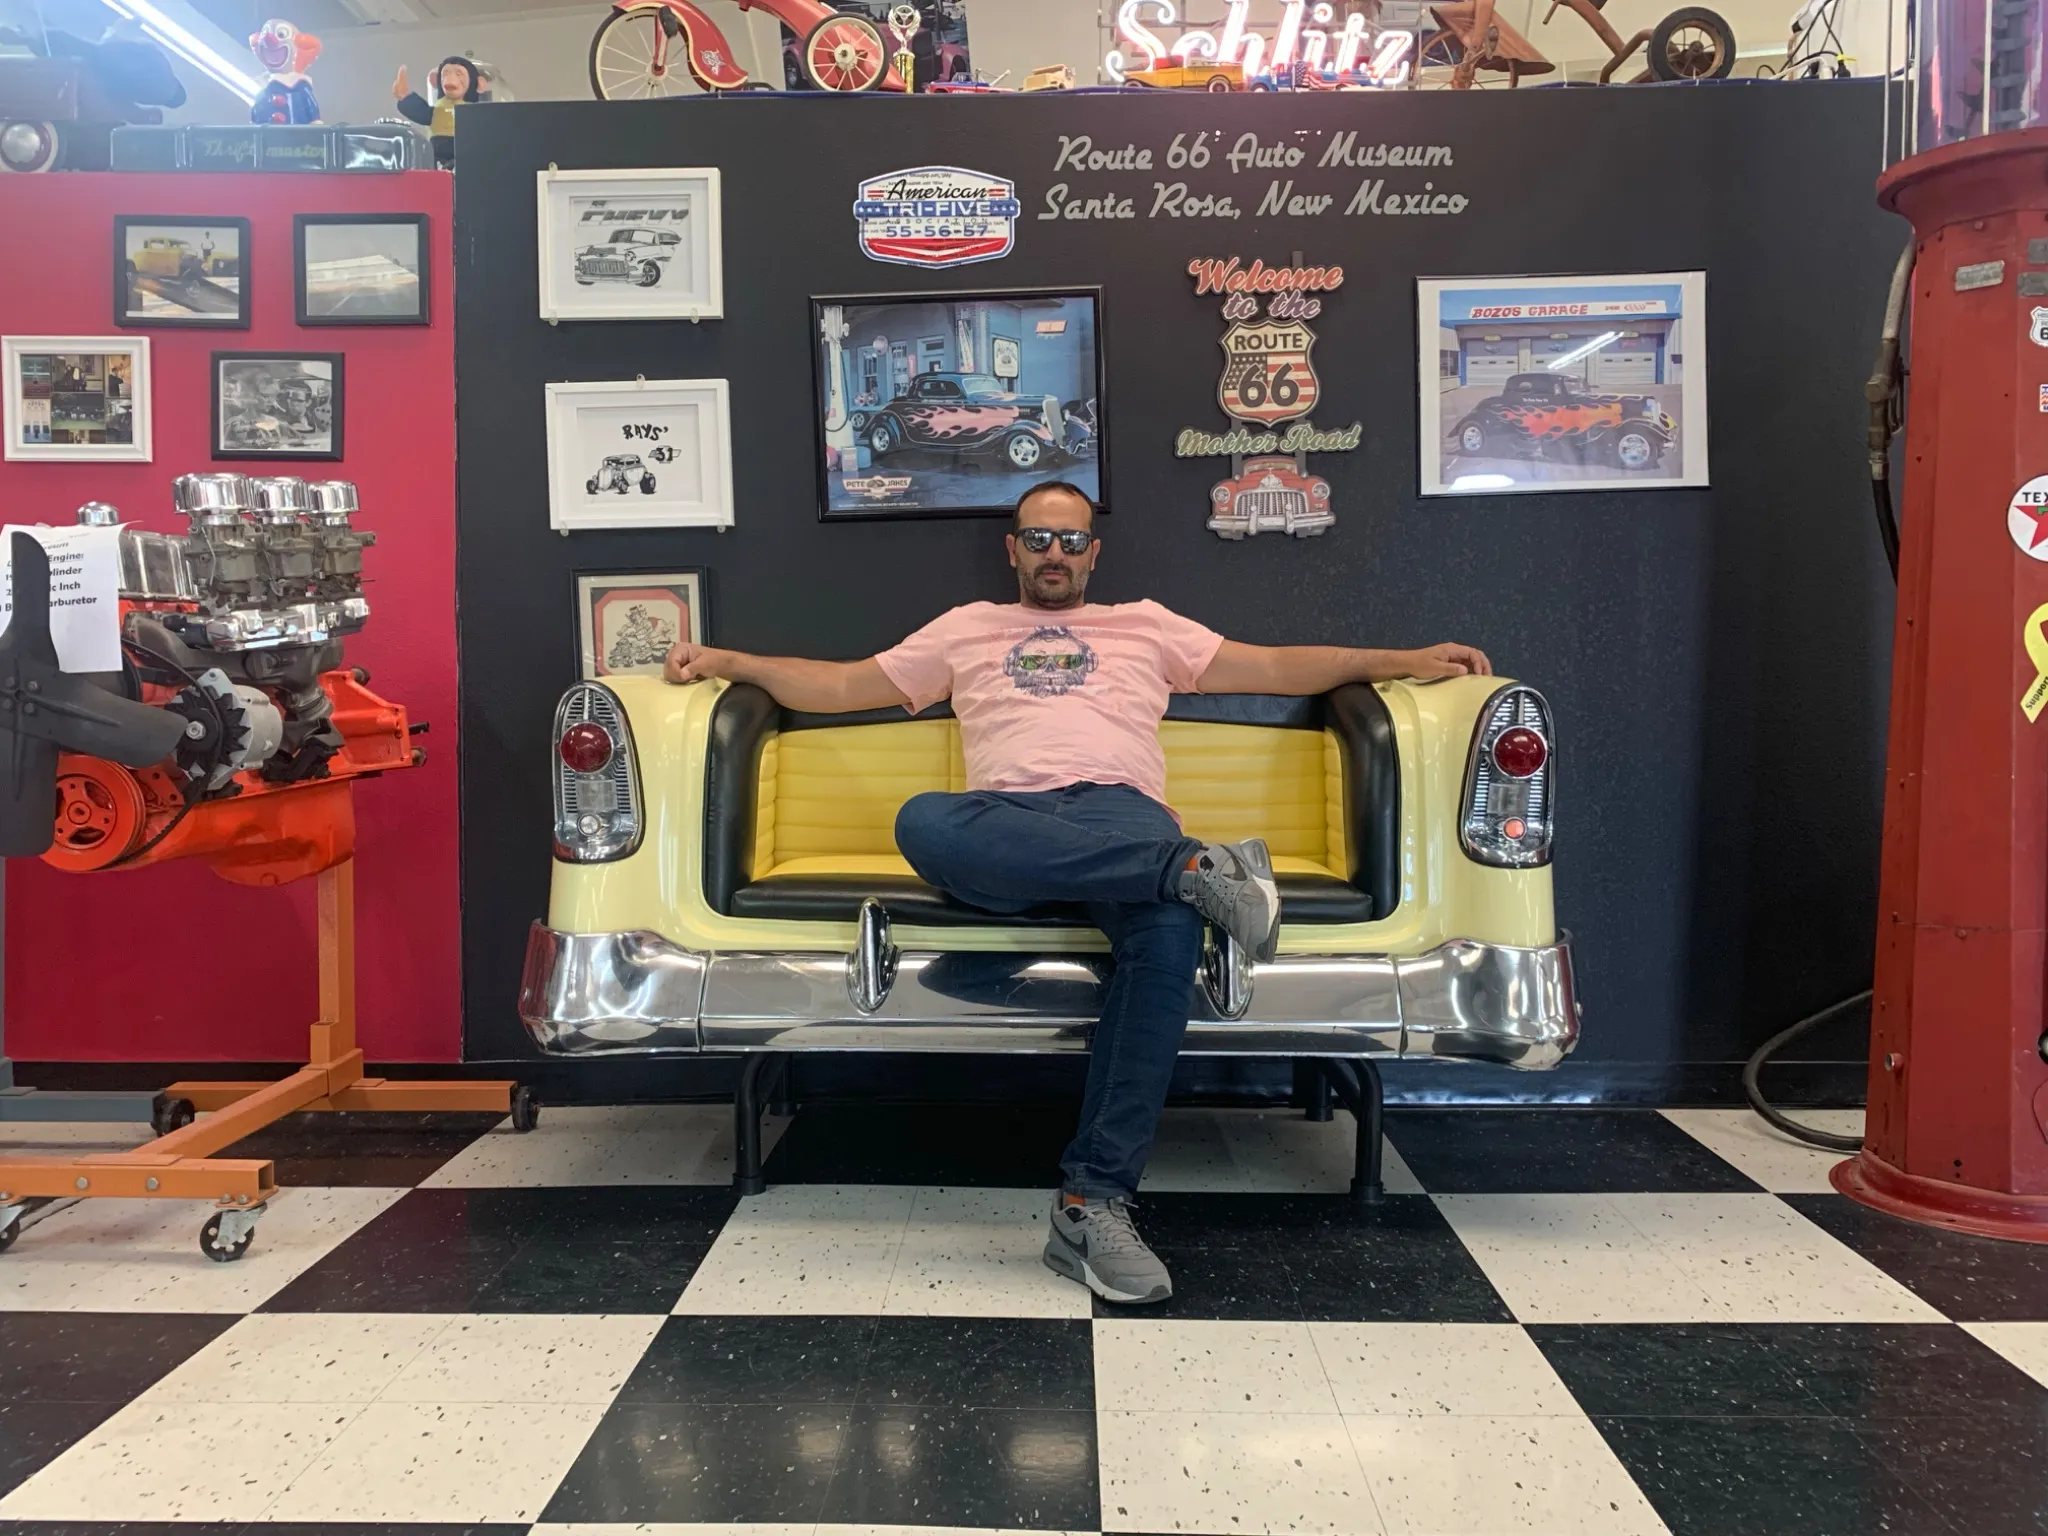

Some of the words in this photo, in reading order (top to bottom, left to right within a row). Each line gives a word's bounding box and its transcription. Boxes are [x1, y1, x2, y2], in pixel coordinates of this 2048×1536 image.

[1105, 0, 1413, 84] Schlitz
[1054, 135, 1153, 171] Route
[1166, 133, 1211, 169] 66
[1225, 132, 1305, 174] Auto
[1317, 131, 1454, 167] Museum
[887, 179, 987, 200] American
[883, 201, 991, 216] TRI-FIVE
[1037, 183, 1135, 220] Santa
[1149, 182, 1241, 220] Rosa,
[1255, 180, 1333, 217] New
[1344, 179, 1469, 216] Mexico
[578, 209, 690, 227] CHEVY
[886, 225, 989, 238] 55-56-57
[1188, 257, 1344, 294] Welcome
[1222, 292, 1259, 320] to
[1268, 288, 1322, 319] the
[1472, 306, 1522, 318] BOZOS
[1528, 304, 1589, 316] GARAGE
[1233, 333, 1303, 351] ROUTE
[2041, 327, 2048, 340] 6
[1239, 362, 1300, 408] 66
[622, 423, 668, 441] RAYS'
[1175, 428, 1279, 457] Mother
[1279, 423, 1363, 450] Road
[655, 447, 673, 462] 31
[846, 480, 866, 488] PETE
[59, 580, 81, 591] Inch
[49, 596, 97, 608] arburetor
